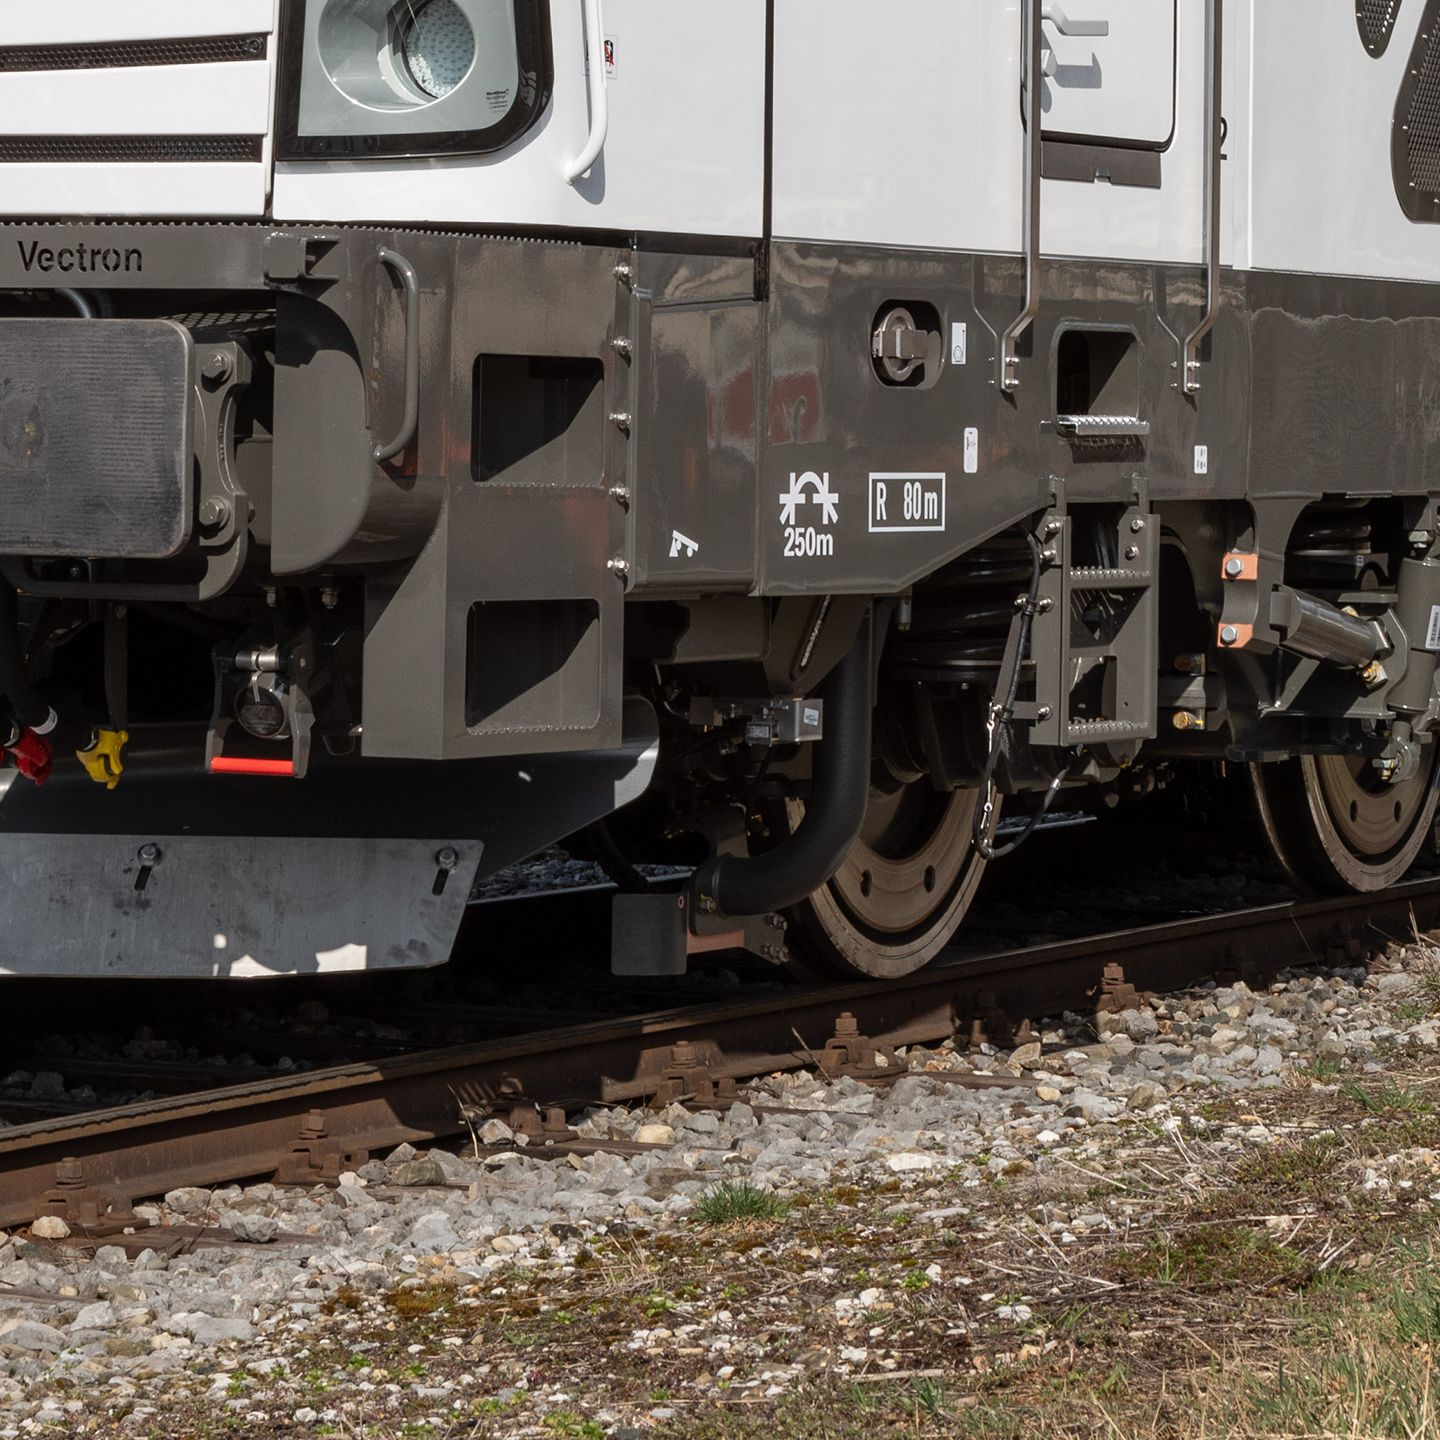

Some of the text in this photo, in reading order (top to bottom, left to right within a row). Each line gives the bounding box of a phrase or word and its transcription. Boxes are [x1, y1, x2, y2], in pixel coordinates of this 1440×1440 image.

[17, 240, 143, 272] Vectron
[876, 481, 887, 521] R
[784, 526, 834, 557] 250m
